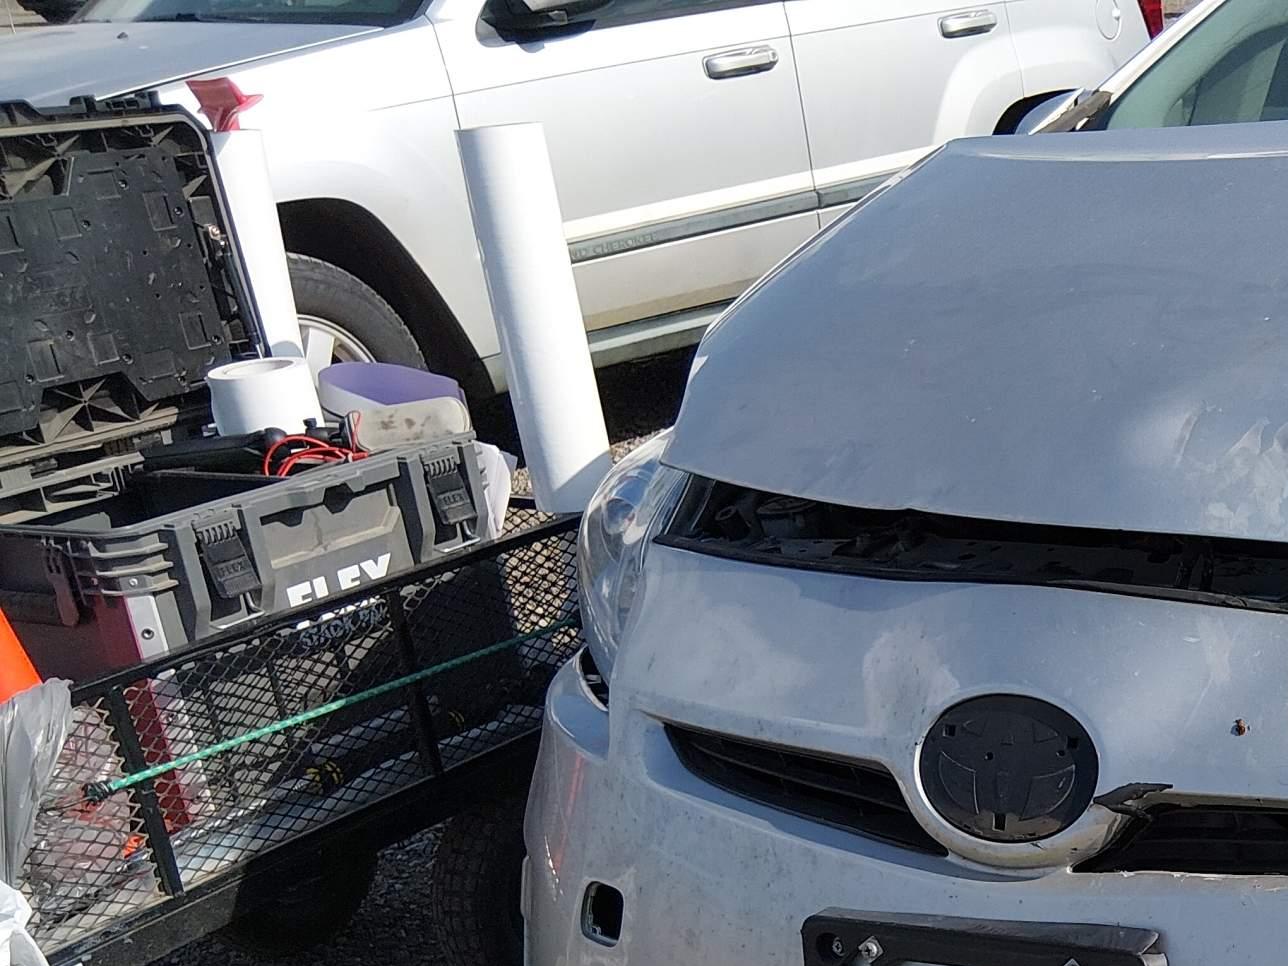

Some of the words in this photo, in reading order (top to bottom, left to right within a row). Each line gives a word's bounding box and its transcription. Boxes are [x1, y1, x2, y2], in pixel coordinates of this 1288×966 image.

[593, 232, 657, 257] CHEROKEE
[443, 493, 465, 505] FLEX
[218, 560, 247, 578] FLEX
